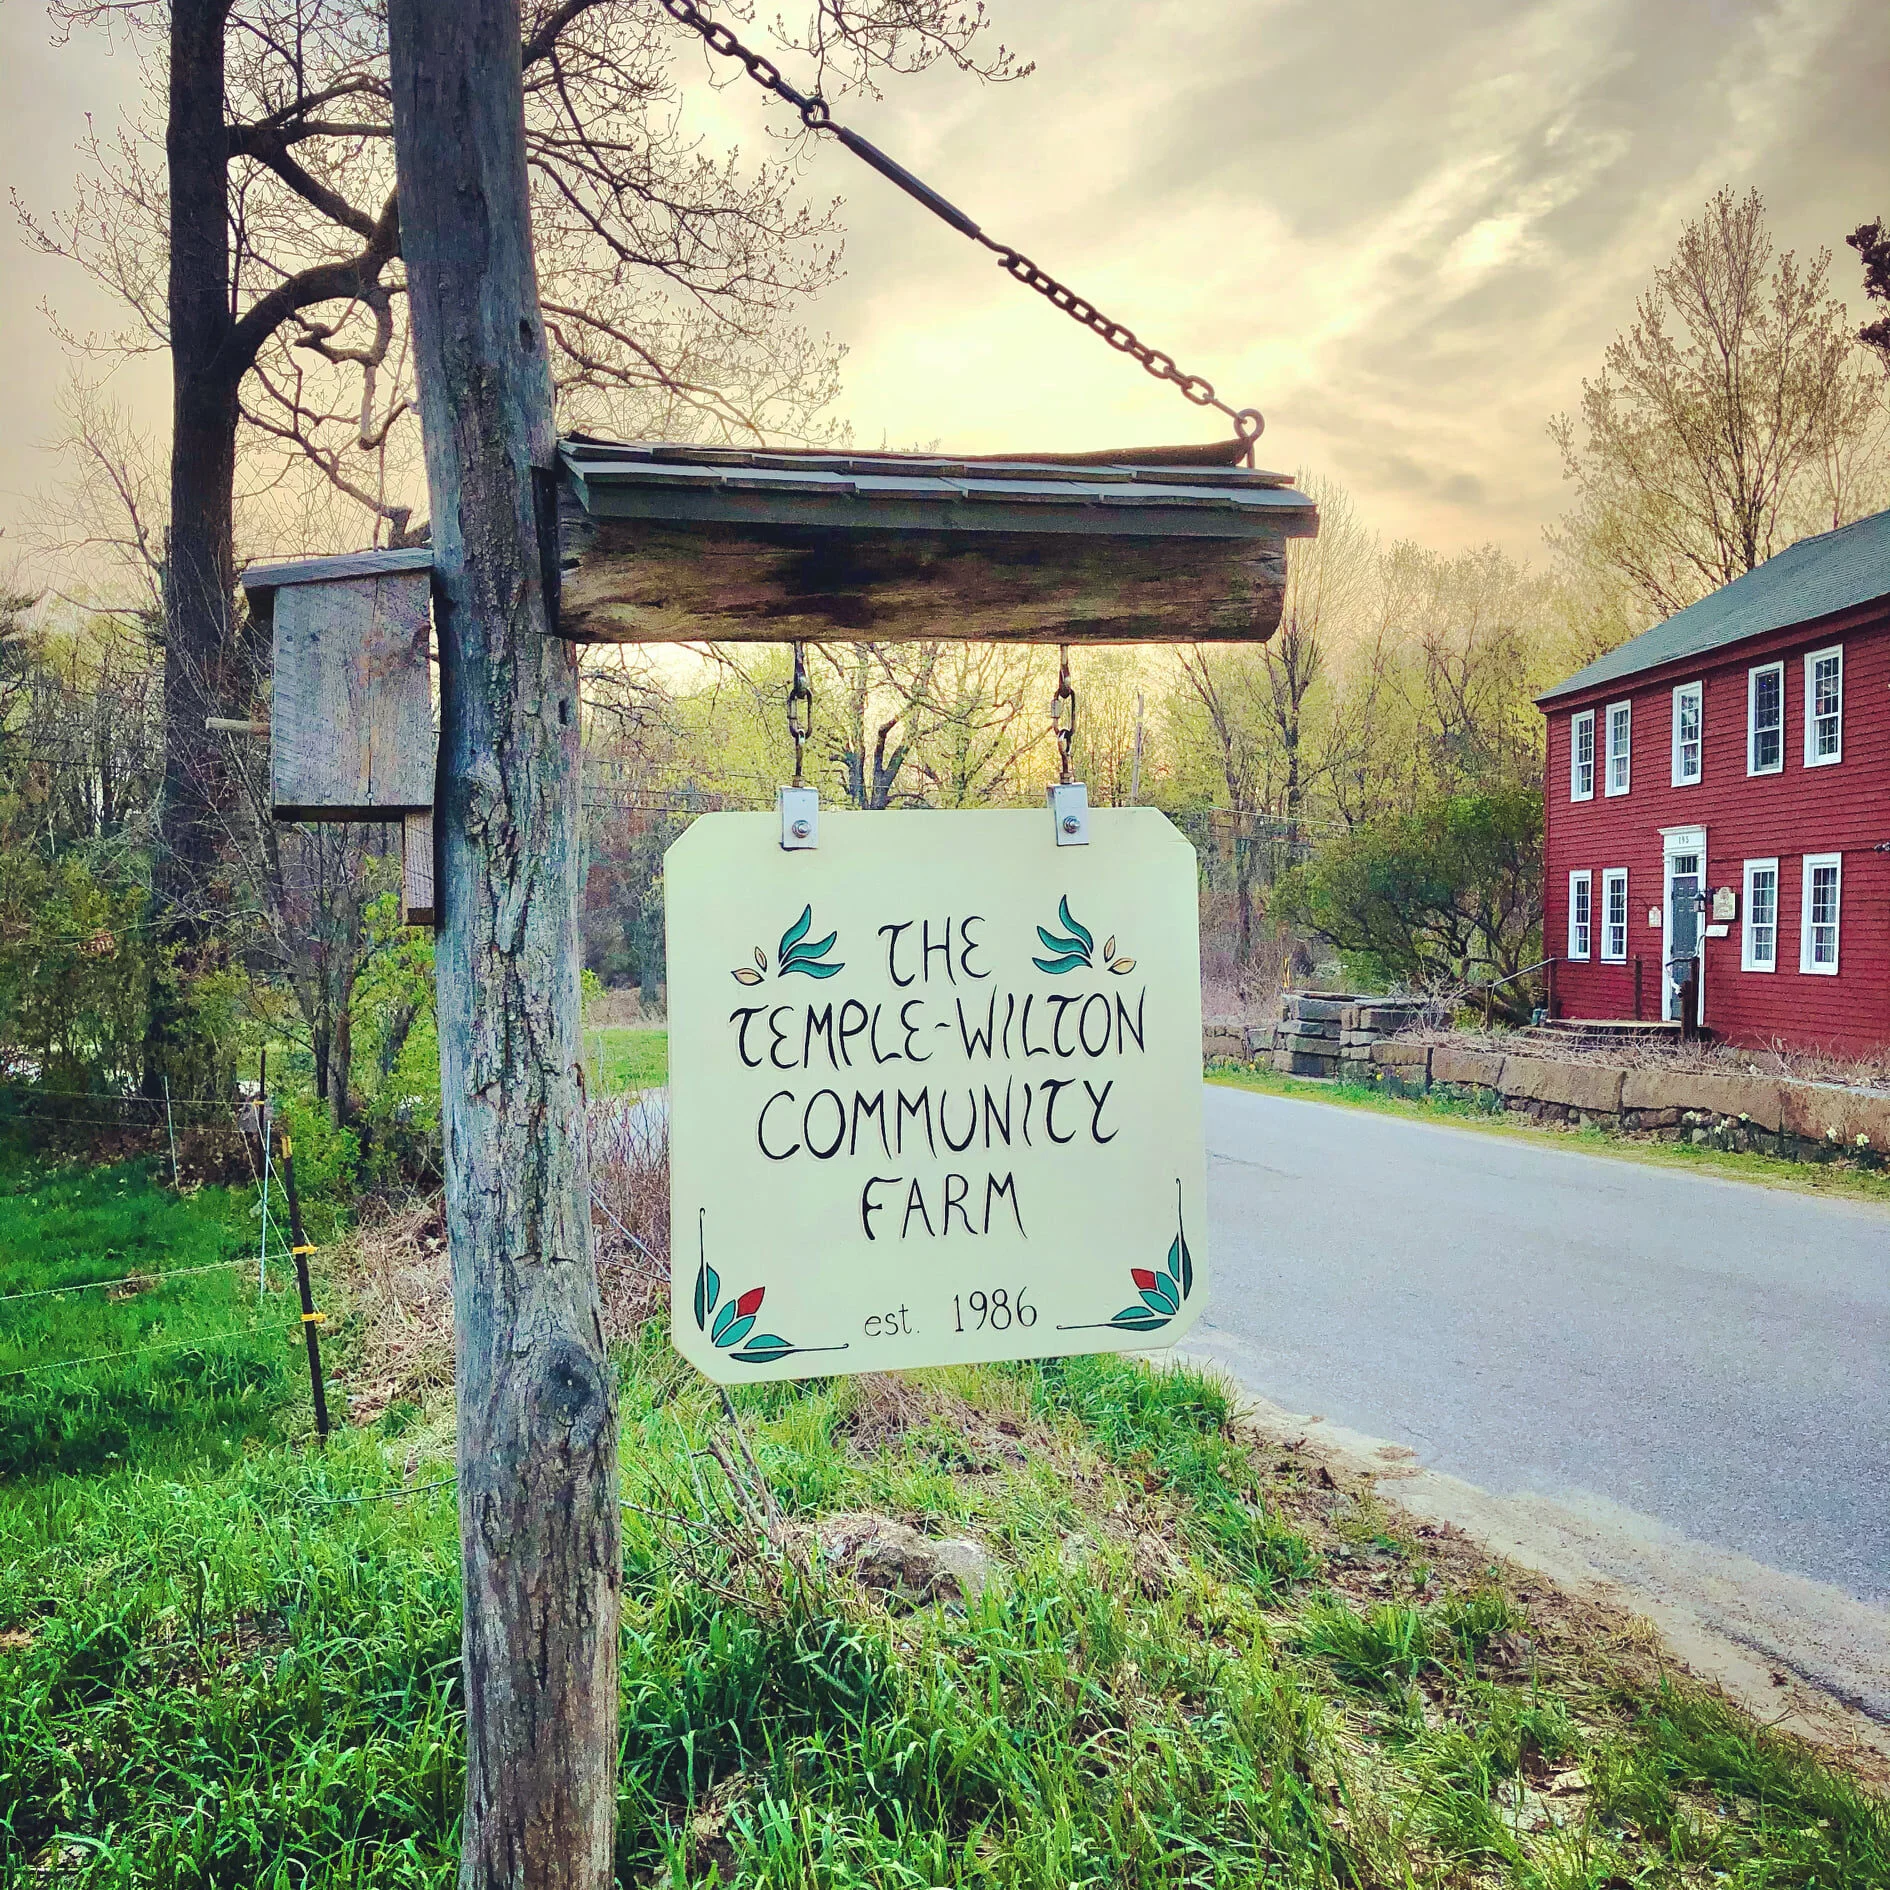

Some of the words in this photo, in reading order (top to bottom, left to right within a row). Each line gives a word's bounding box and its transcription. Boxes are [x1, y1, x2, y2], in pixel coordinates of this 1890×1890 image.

[877, 915, 992, 988] THE
[729, 985, 1146, 1072] TEMPLE-WILTON
[757, 1074, 1119, 1161] COMMUNITY
[861, 1171, 1028, 1241] FARM
[864, 1303, 920, 1337] est.
[953, 1286, 1038, 1333] 1986
